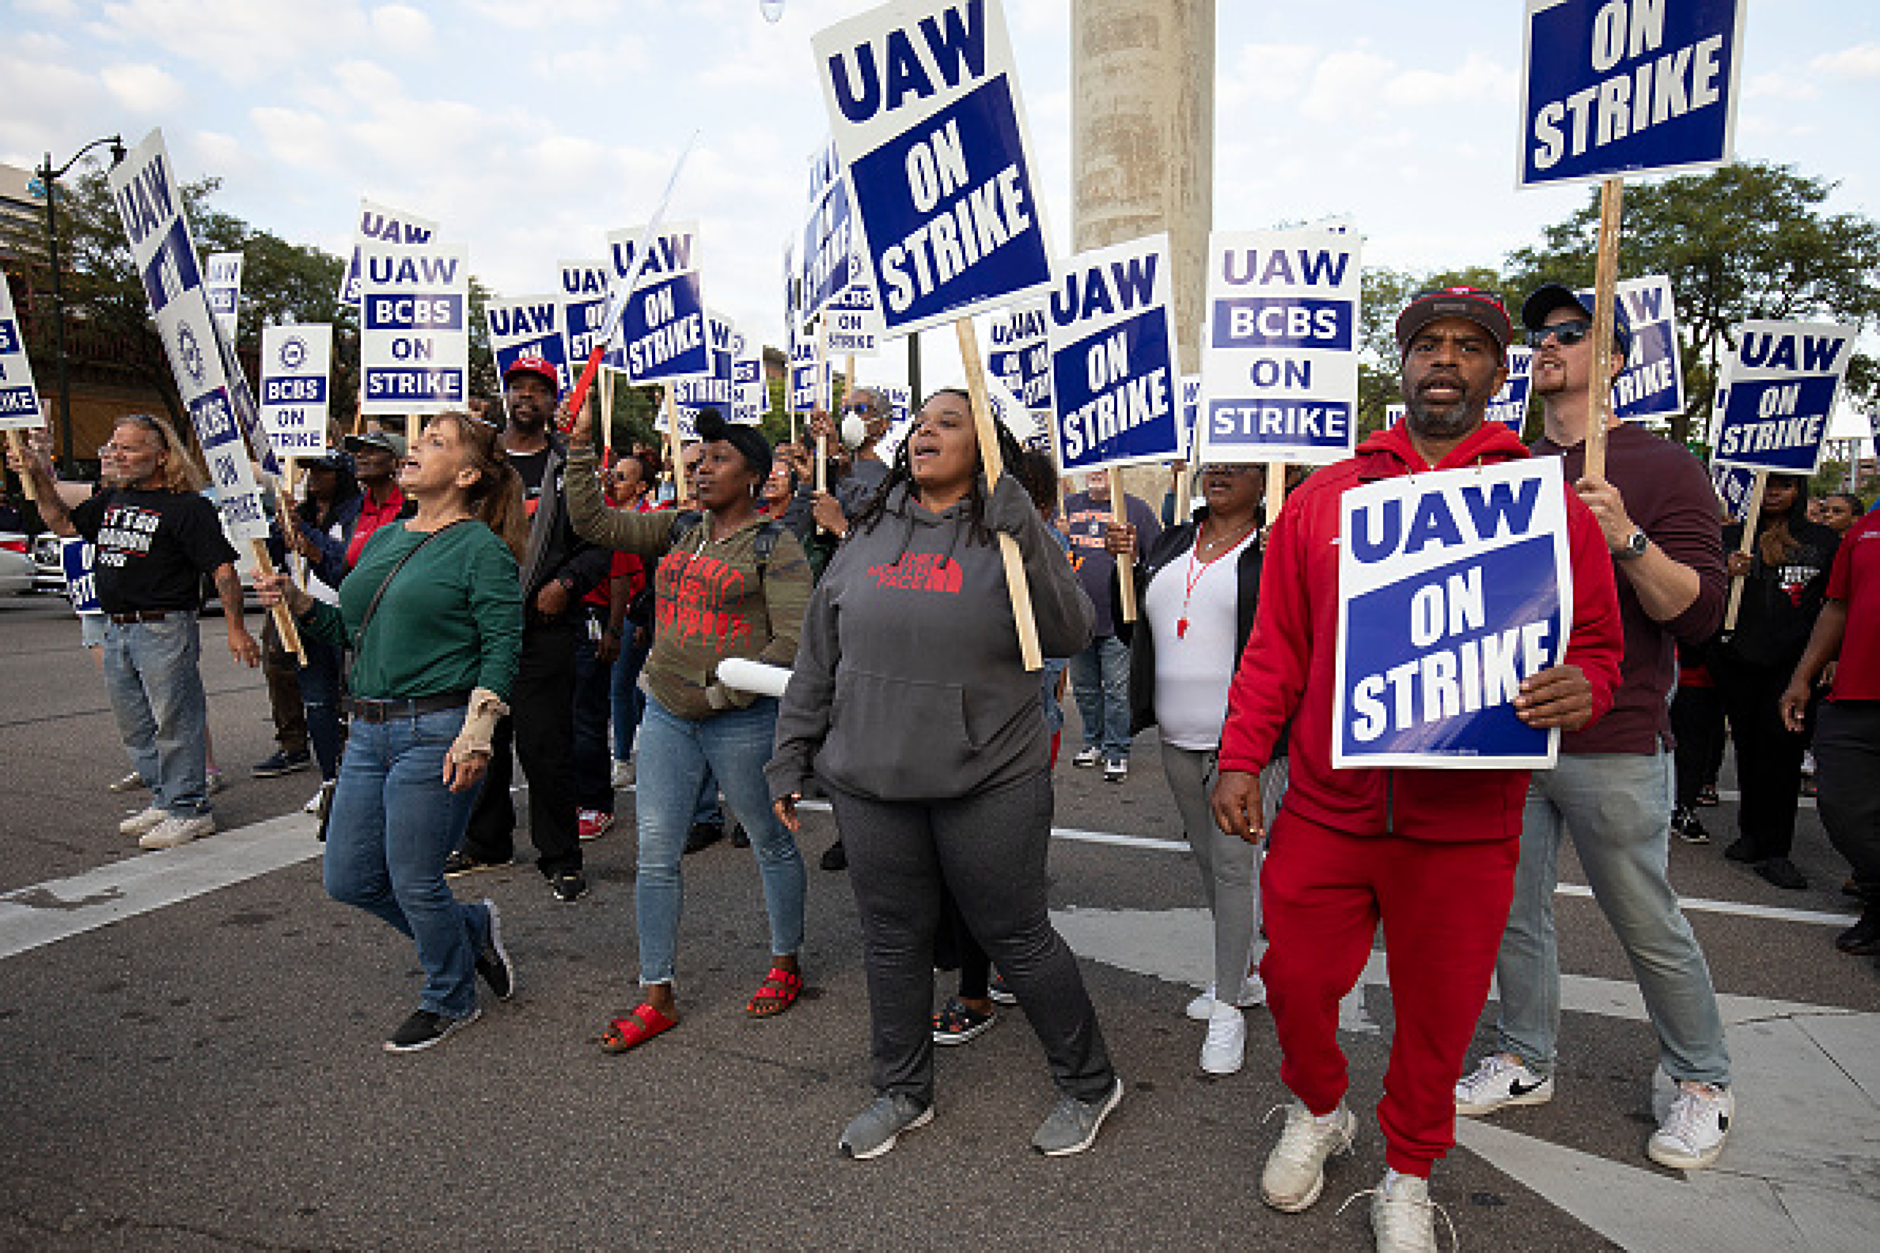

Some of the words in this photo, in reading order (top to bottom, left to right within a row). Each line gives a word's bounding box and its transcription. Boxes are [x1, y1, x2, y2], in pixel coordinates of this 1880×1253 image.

[1592, 0, 1665, 72] ON
[828, 0, 985, 124] UAW
[1534, 34, 1722, 170] STRIKE
[905, 116, 969, 213] ON
[363, 211, 431, 244] UAW
[880, 164, 1029, 313] STRIKE
[369, 256, 459, 285] UAW
[1224, 249, 1350, 286] UAW
[645, 284, 675, 329] ON
[1050, 253, 1158, 327] UAW
[375, 299, 450, 324] BCBS
[490, 303, 555, 336] UAW
[1230, 306, 1337, 339] BCBS
[392, 337, 432, 361] ON
[629, 312, 701, 375] STRIKE
[1088, 331, 1128, 393] ON
[1740, 331, 1845, 371] UAW
[268, 379, 318, 399] BCBS
[369, 372, 460, 394] STRIKE
[1251, 357, 1312, 390] ON
[277, 408, 305, 428] ON
[1063, 367, 1169, 460] STRIKE
[1758, 383, 1802, 419] ON
[1214, 406, 1346, 438] STRIKE
[1721, 414, 1824, 457] STRIKE
[1350, 477, 1542, 564] UAW
[1411, 565, 1485, 648] ON
[1353, 620, 1549, 742] STRIKE
